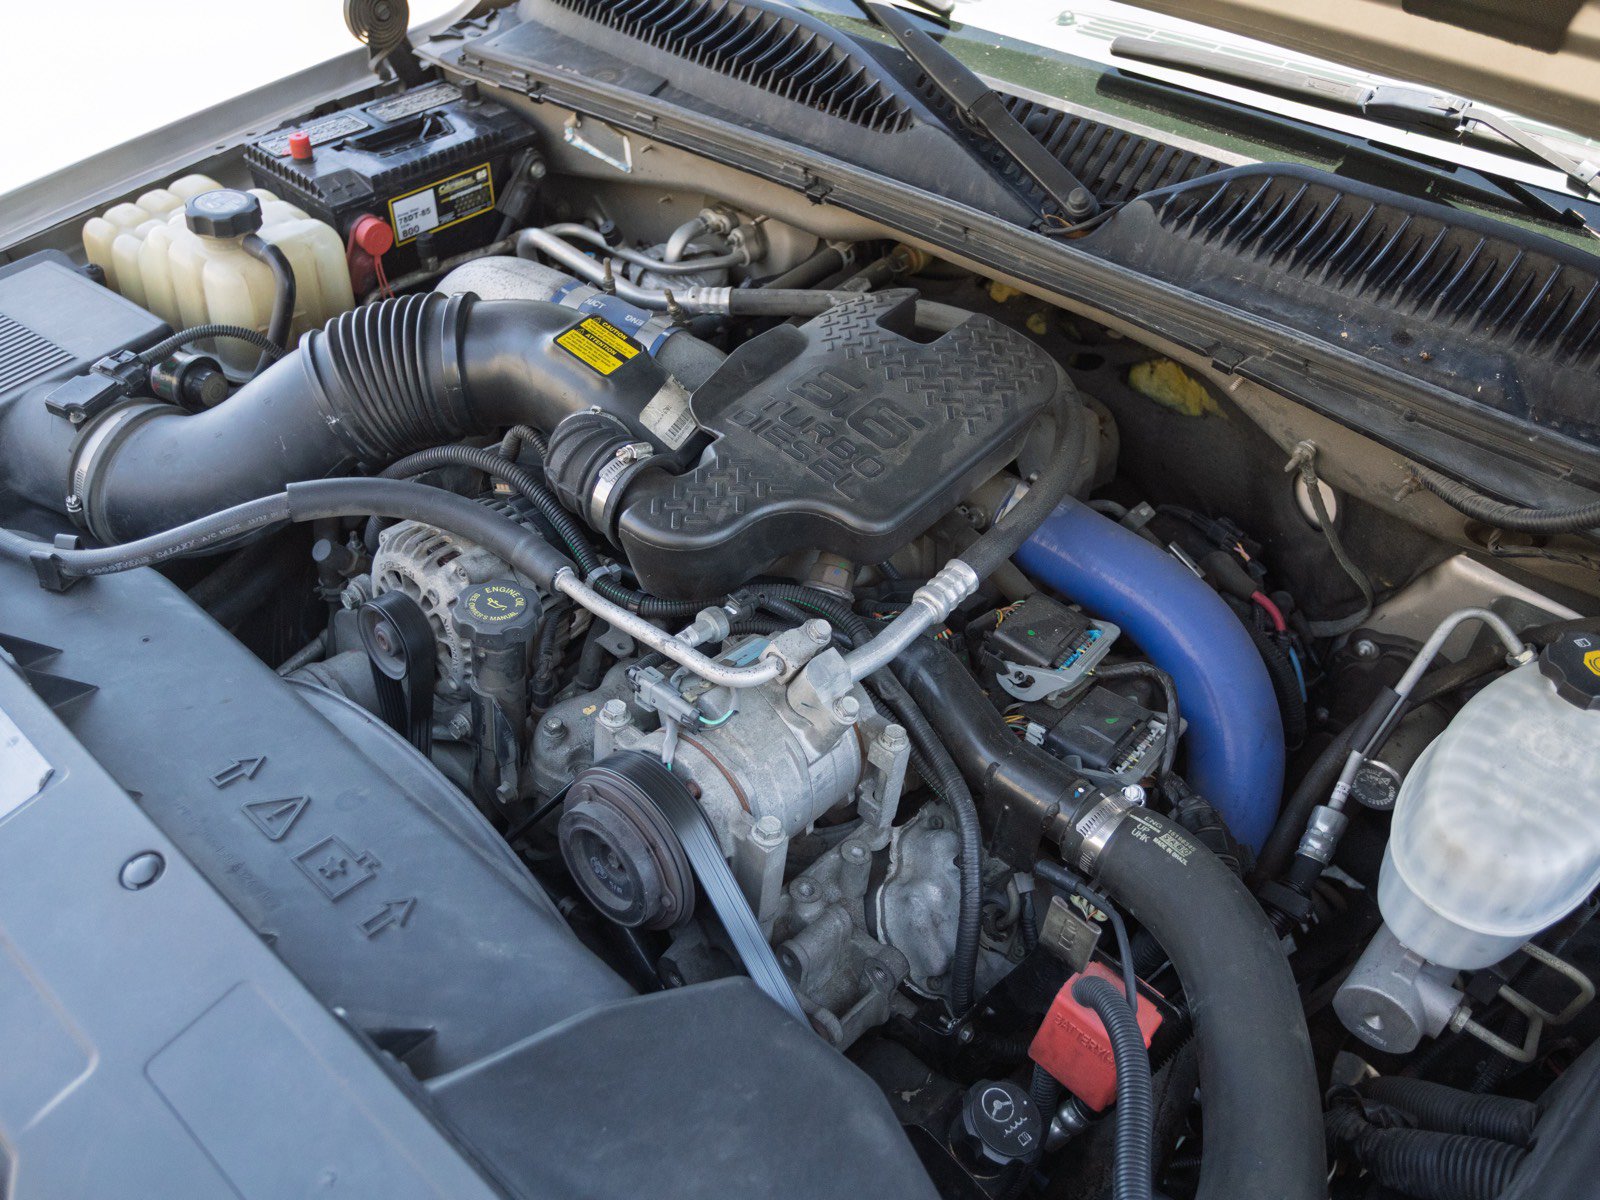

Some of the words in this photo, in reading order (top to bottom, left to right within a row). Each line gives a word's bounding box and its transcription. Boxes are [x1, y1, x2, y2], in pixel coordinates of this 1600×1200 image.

[401, 225, 420, 238] 800
[602, 321, 628, 341] CAUTION
[585, 332, 617, 356] ATTENTION
[760, 394, 886, 480] TURBO
[725, 407, 856, 501] DIESEL
[484, 586, 521, 599] ENGINE
[489, 611, 519, 621] MANUAL
[1136, 824, 1150, 833] UP
[1153, 837, 1168, 851] MADE
[1171, 850, 1189, 866] BRAZIL
